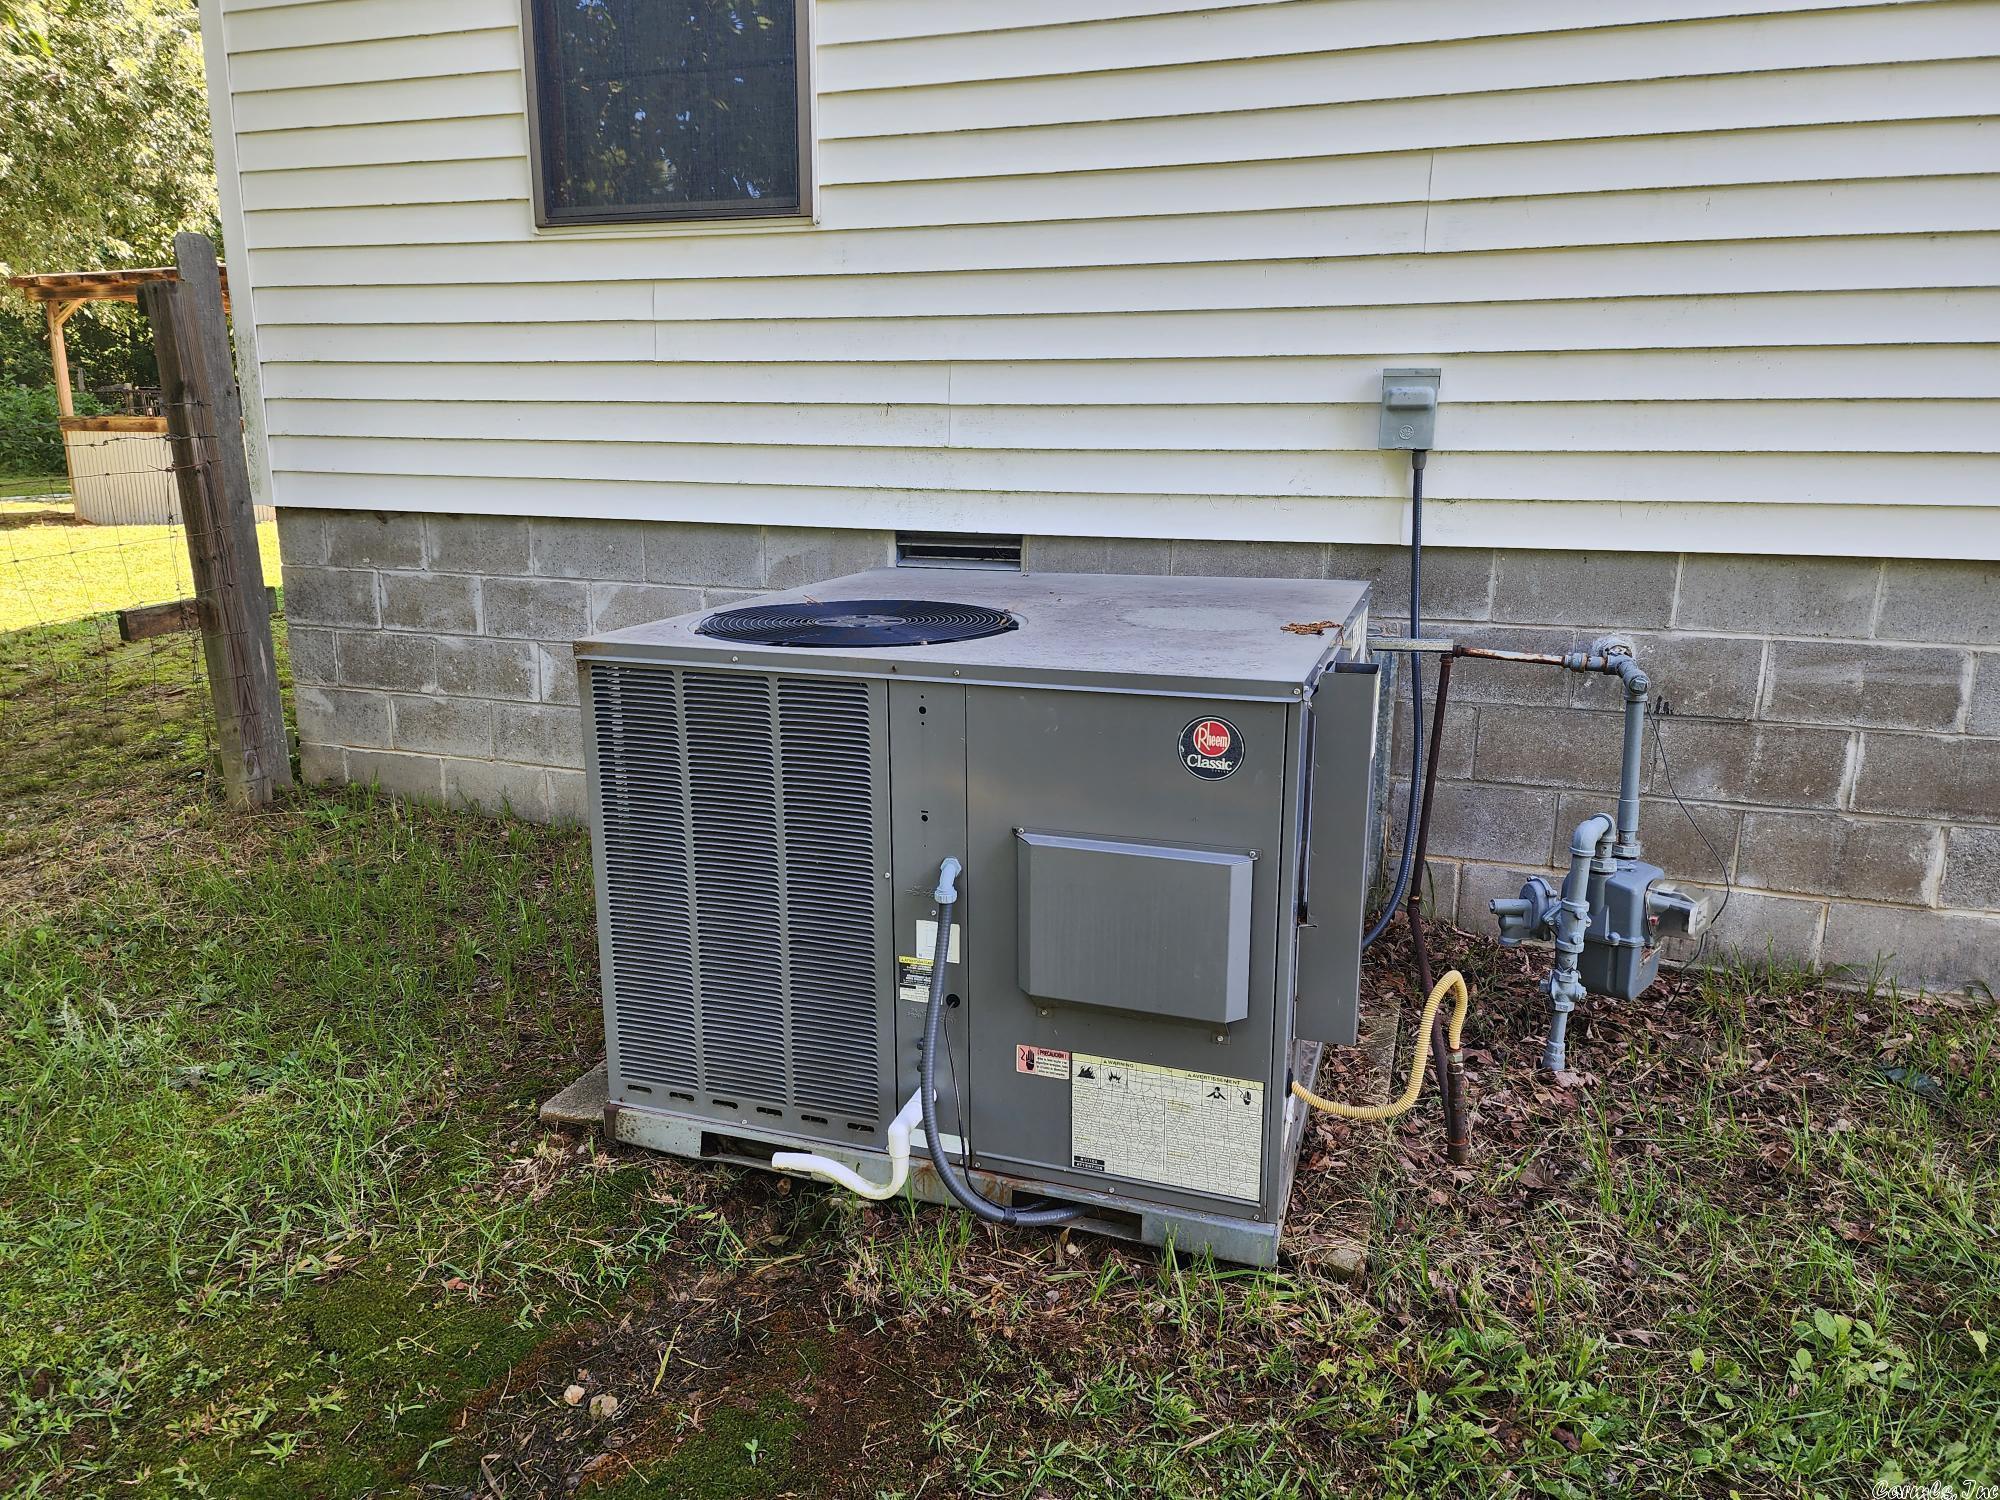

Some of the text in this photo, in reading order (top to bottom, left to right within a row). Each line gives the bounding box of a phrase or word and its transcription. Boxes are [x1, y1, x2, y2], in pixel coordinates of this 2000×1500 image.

[1198, 722, 1228, 751] Rheem
[1187, 754, 1232, 770] Classic
[1107, 1059, 1134, 1068] WARNING
